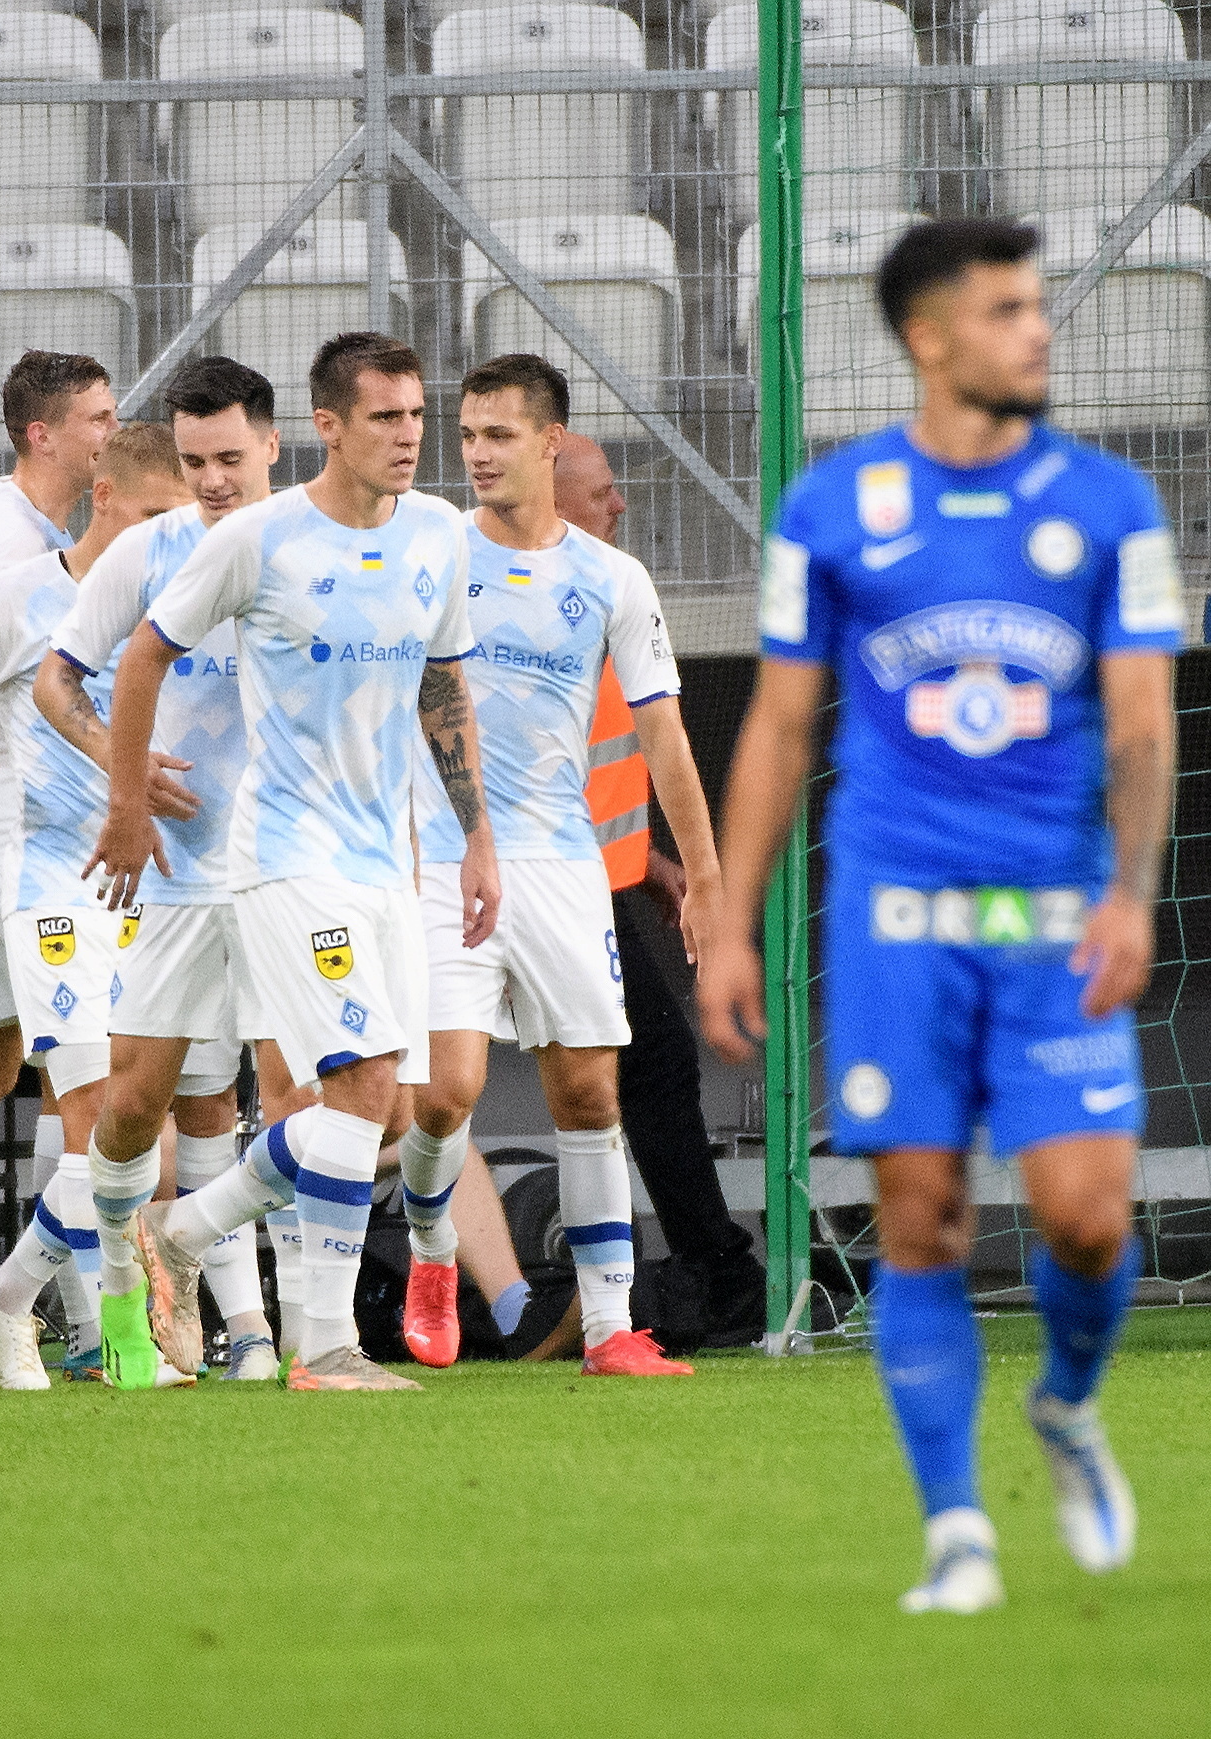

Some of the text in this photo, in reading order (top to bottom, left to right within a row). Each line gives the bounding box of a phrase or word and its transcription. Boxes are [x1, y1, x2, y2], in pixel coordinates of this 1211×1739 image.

[802, 18, 820, 31] 22
[1068, 15, 1087, 28] 23
[529, 25, 546, 38] 21
[290, 238, 308, 251] 19
[39, 918, 72, 936] KLO
[313, 929, 348, 950] KLO
